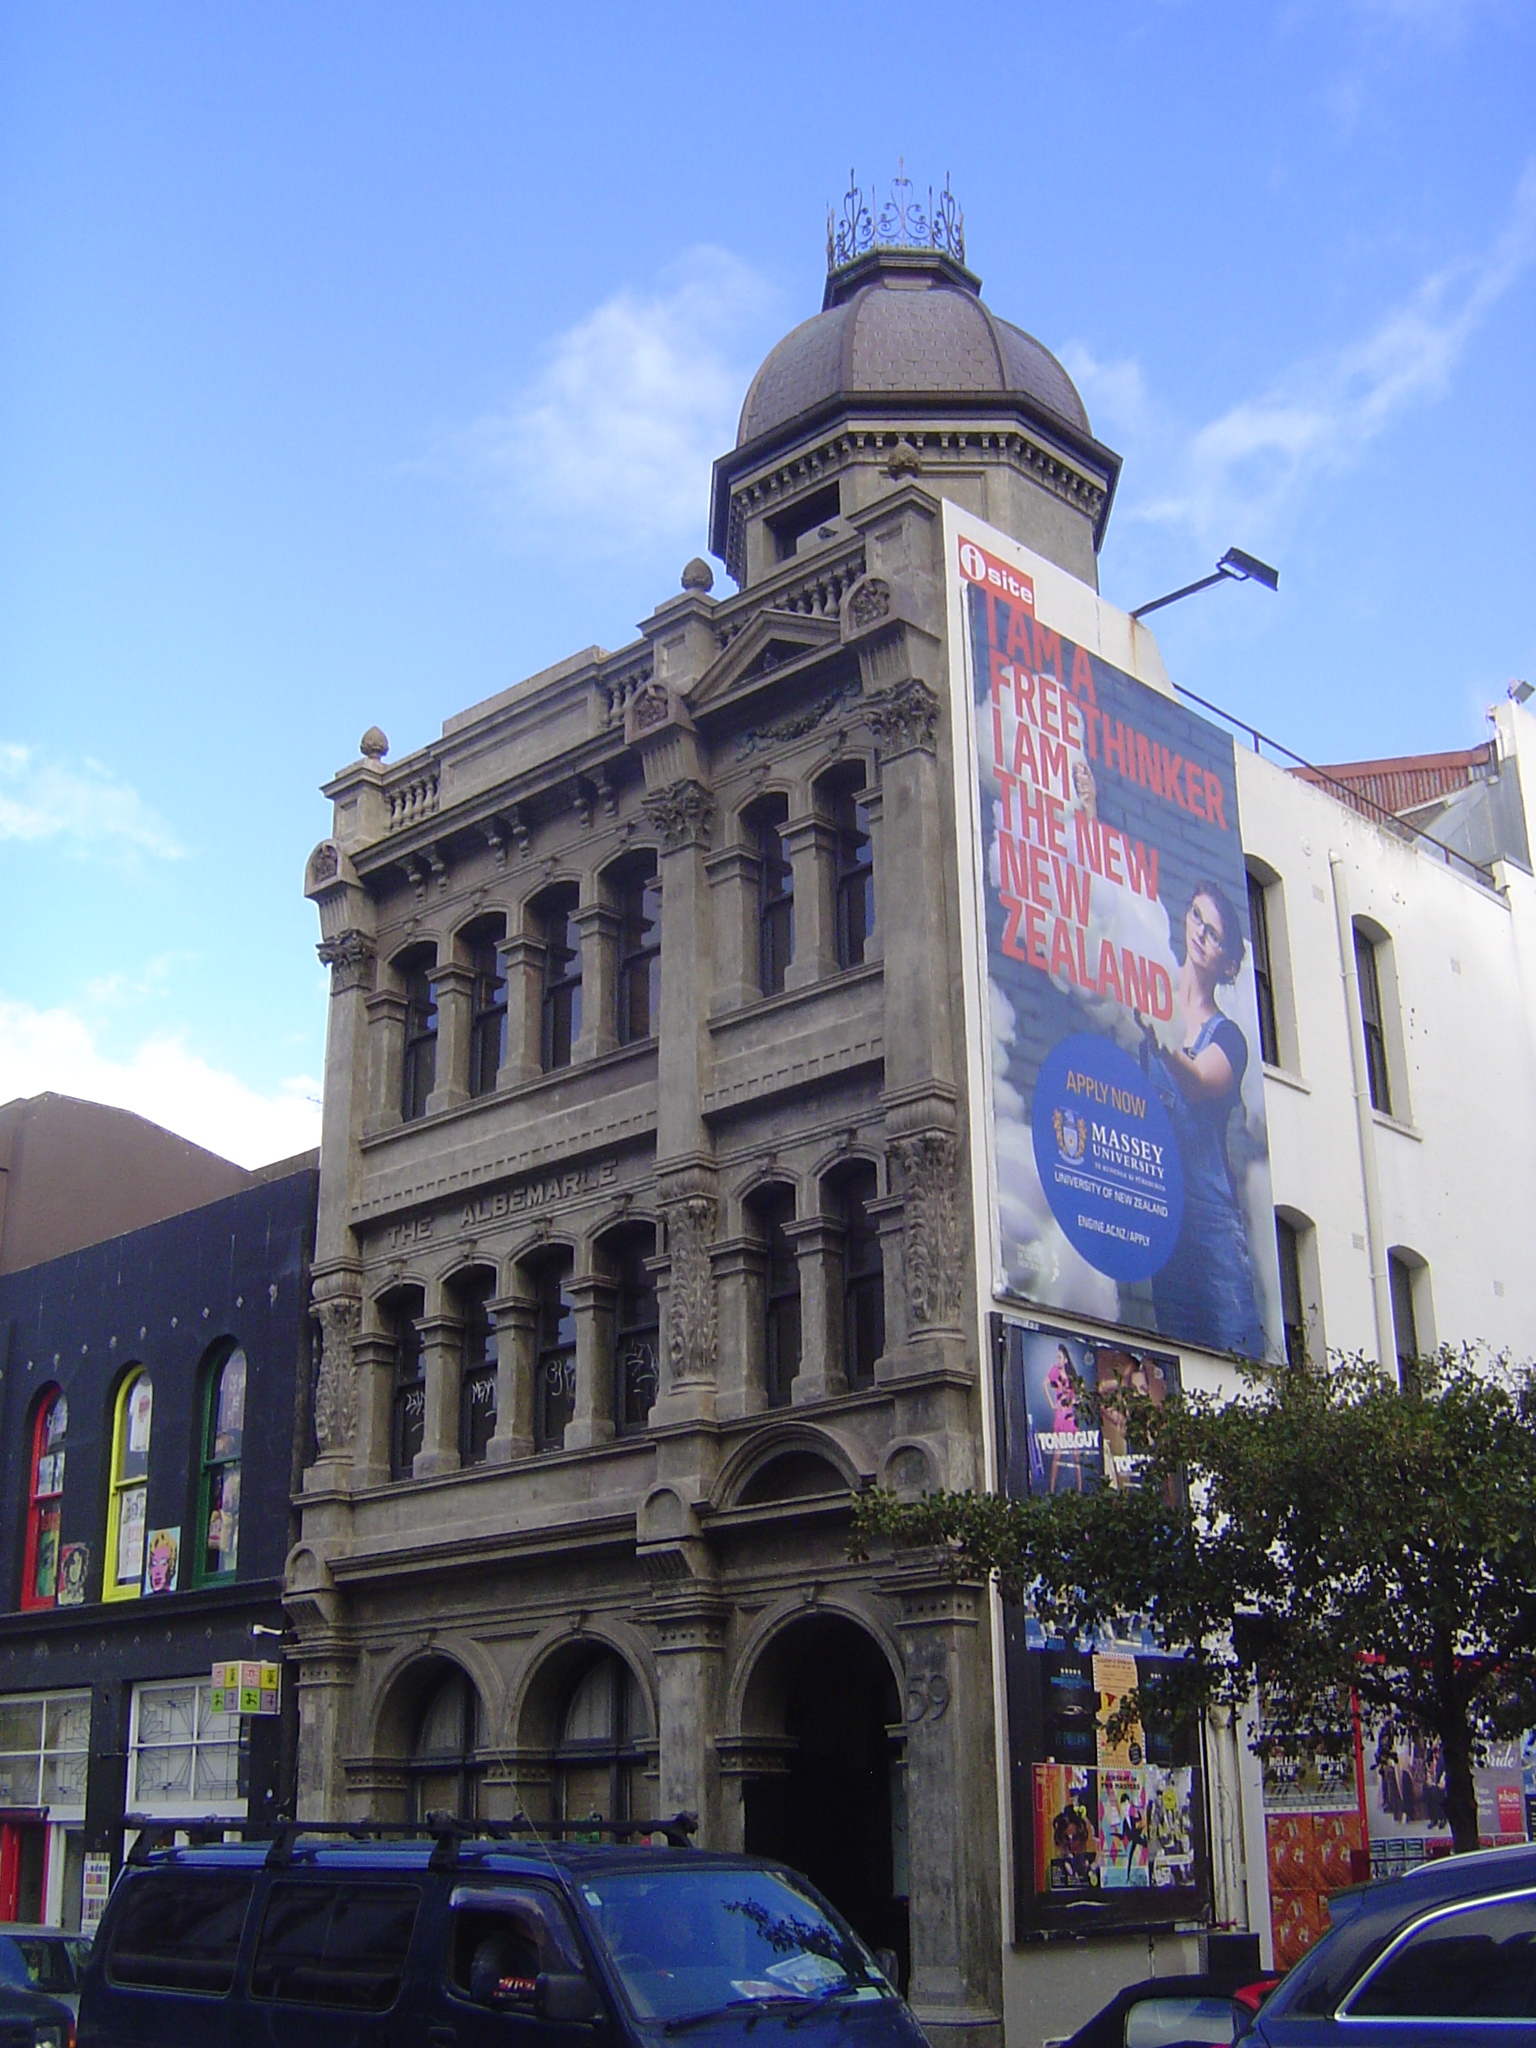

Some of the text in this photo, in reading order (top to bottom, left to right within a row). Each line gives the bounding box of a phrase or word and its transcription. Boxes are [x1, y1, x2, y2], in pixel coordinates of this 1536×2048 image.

[987, 566, 1033, 605] site
[986, 589, 1097, 705] I AM A
[992, 706, 1071, 801] I AM
[993, 766, 1160, 902] THE NEW
[998, 829, 1092, 927] NEW
[1000, 895, 1174, 1022] ZEALAND
[1066, 1069, 1146, 1119] APPLY NOW
[1091, 1121, 1164, 1165] MASSEY
[1092, 1143, 1165, 1179] UNIVERSITY
[388, 1159, 619, 1249] THE ALBEMARLE
[1054, 1171, 1102, 1196] UNIVERSITY
[1102, 1186, 1113, 1199] OF
[1114, 1190, 1133, 1207] NEW
[1133, 1196, 1169, 1218] ZEALAND
[1038, 1430, 1100, 1451] TONI&GUY
